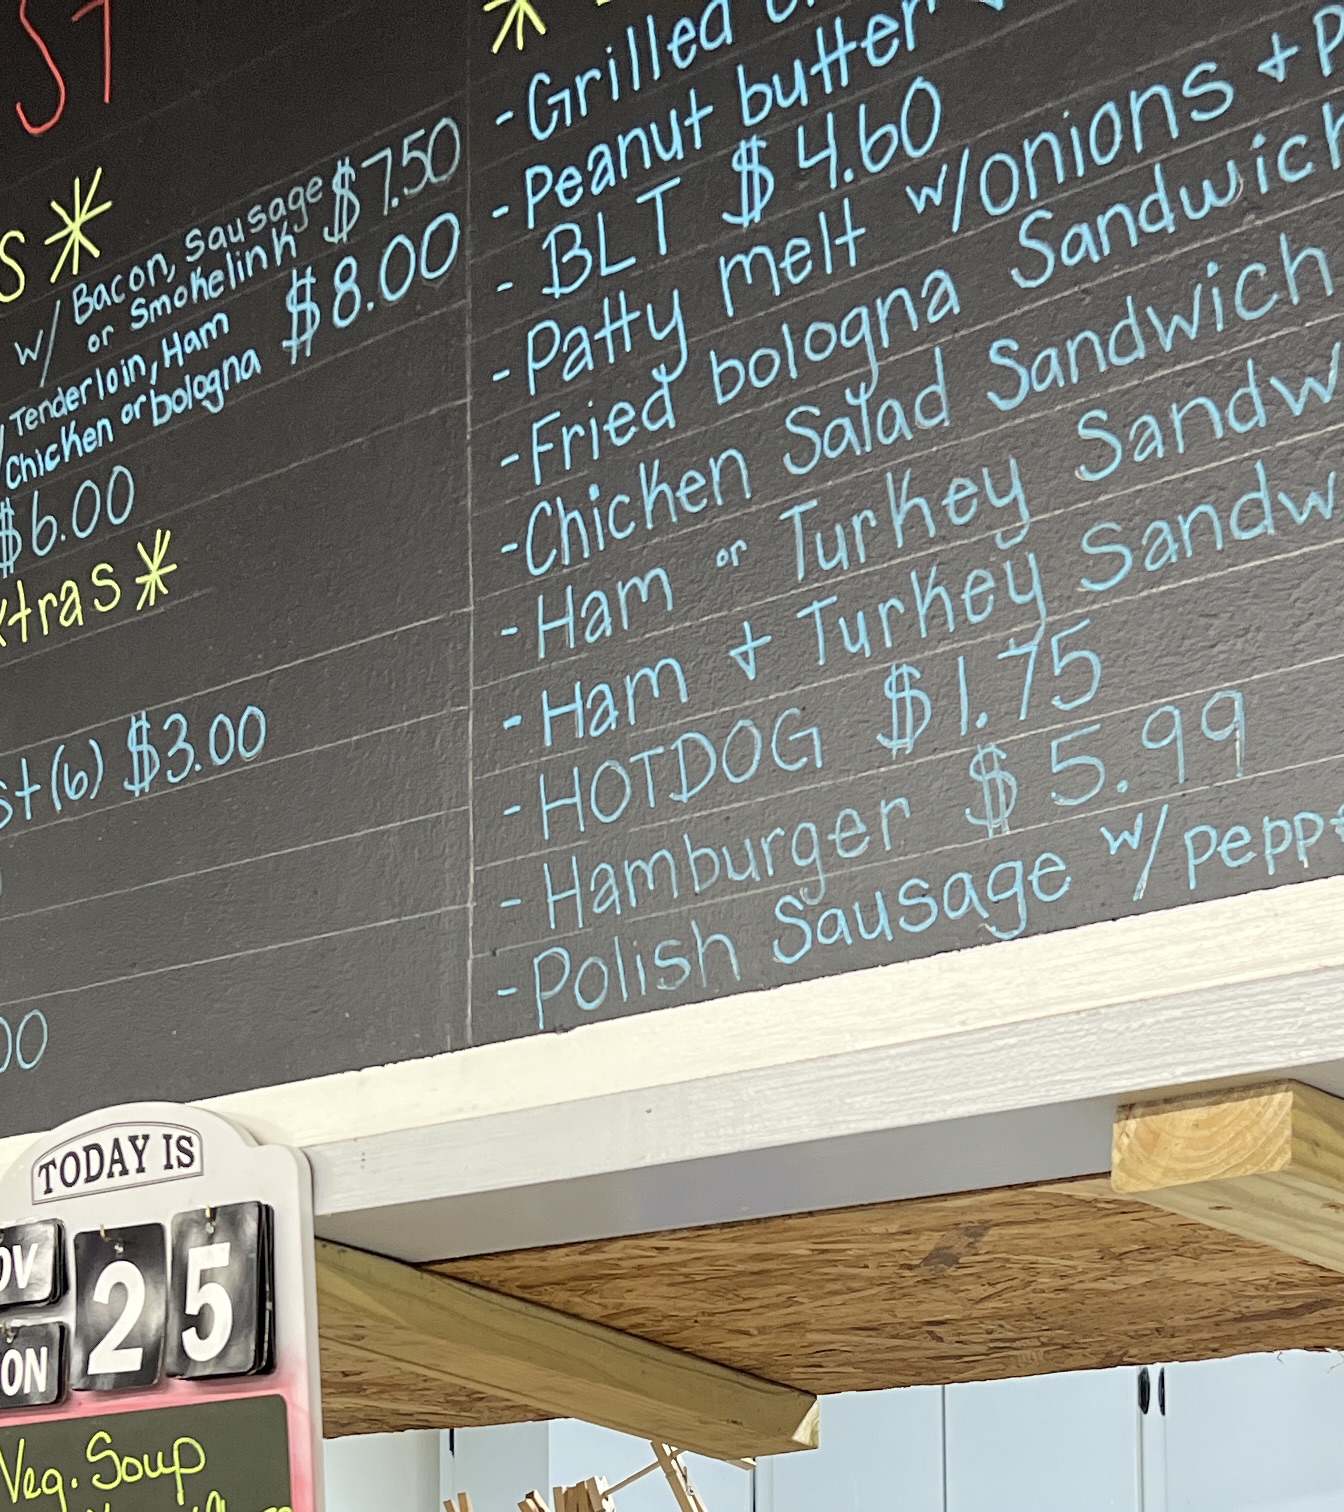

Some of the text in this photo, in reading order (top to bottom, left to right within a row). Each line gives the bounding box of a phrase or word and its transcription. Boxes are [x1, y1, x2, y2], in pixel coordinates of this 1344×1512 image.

[184, 175, 323, 262] Sausage
[324, 117, 461, 244] $7.50
[88, 221, 297, 353] or Smokelink
[162, 312, 230, 370] Ham
[282, 212, 461, 364] $8.00
[720, 198, 866, 317] melt
[711, 269, 961, 403] bologna
[784, 346, 949, 475] Salad
[987, 233, 1334, 410] Sandwich
[5, 349, 262, 490] Chicken or bologna
[716, 540, 747, 568] or
[780, 456, 1031, 581] Turkey
[798, 552, 1048, 647] Turkey
[123, 705, 267, 797] $3.00
[876, 619, 1102, 759] $1.75
[773, 851, 1071, 964] Sausage
[38, 1134, 196, 1195] TODAY IS
[86, 1430, 206, 1505] Soup
